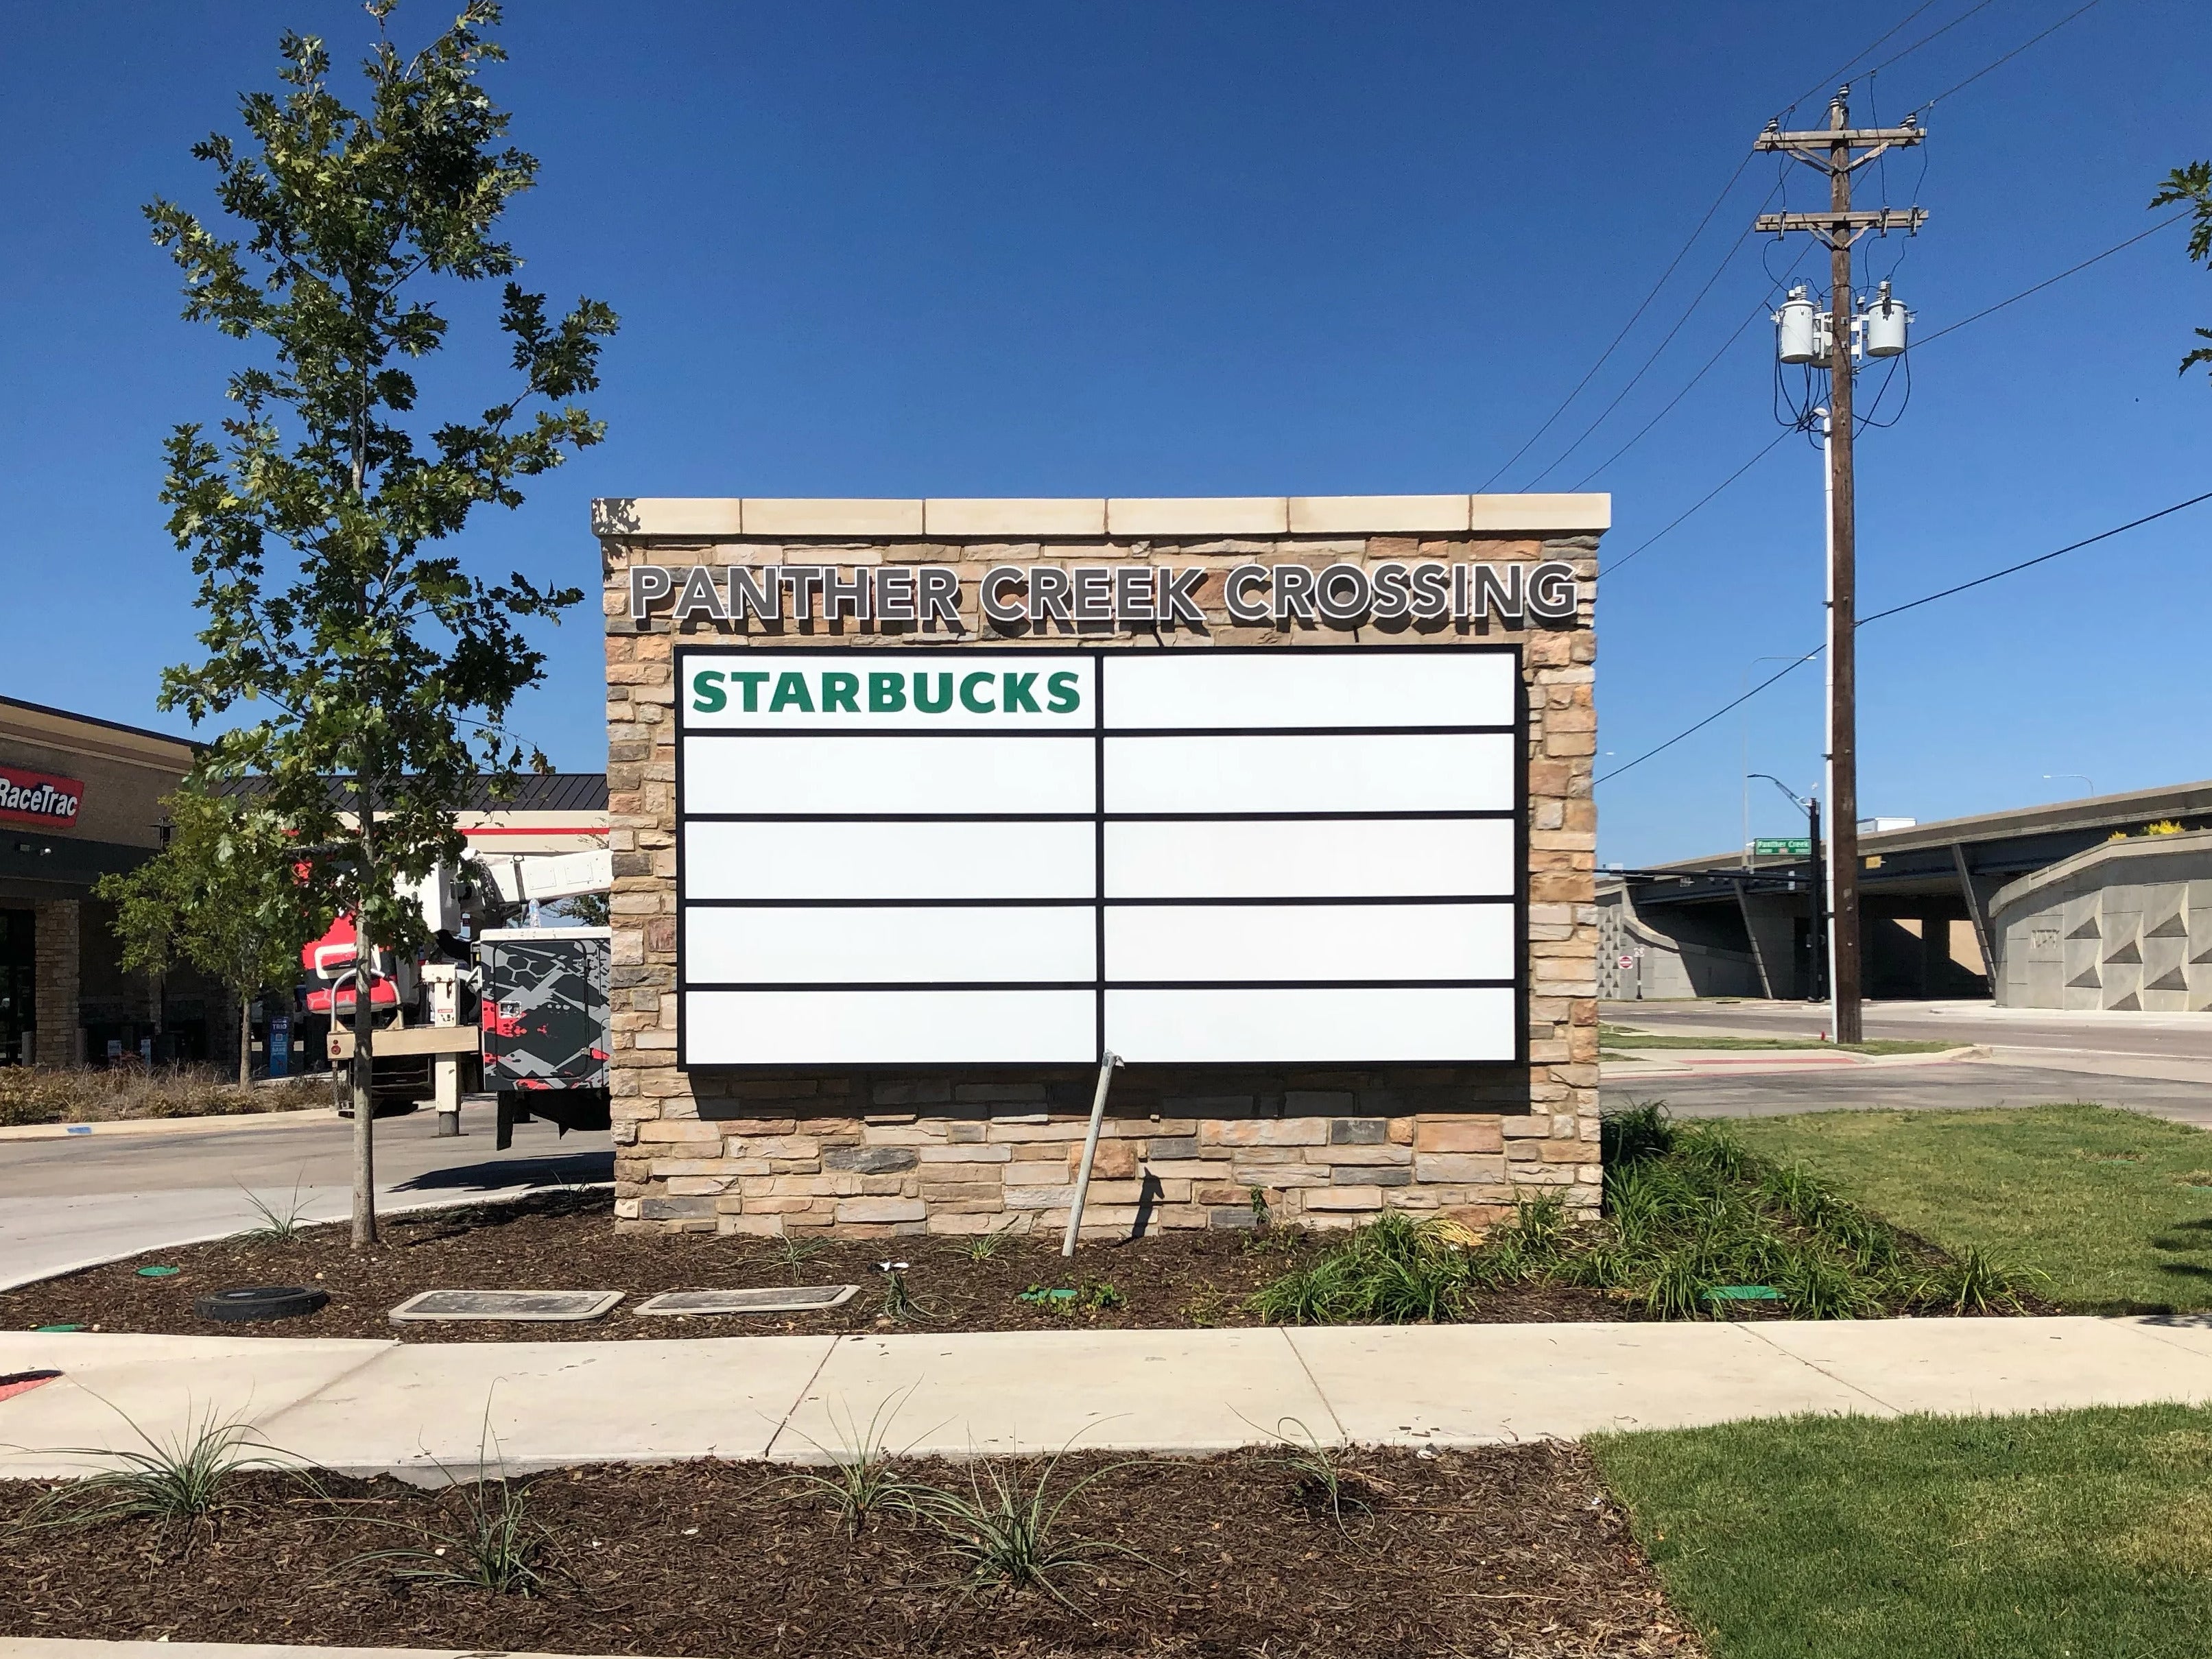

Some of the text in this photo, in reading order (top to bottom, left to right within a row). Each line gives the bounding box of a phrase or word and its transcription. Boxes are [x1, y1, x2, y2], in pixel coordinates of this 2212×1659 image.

[630, 562, 1577, 621] PANTHER CREEK CROSSING
[693, 670, 1080, 713] STARBUCKS
[0, 778, 78, 816] RaceTrac
